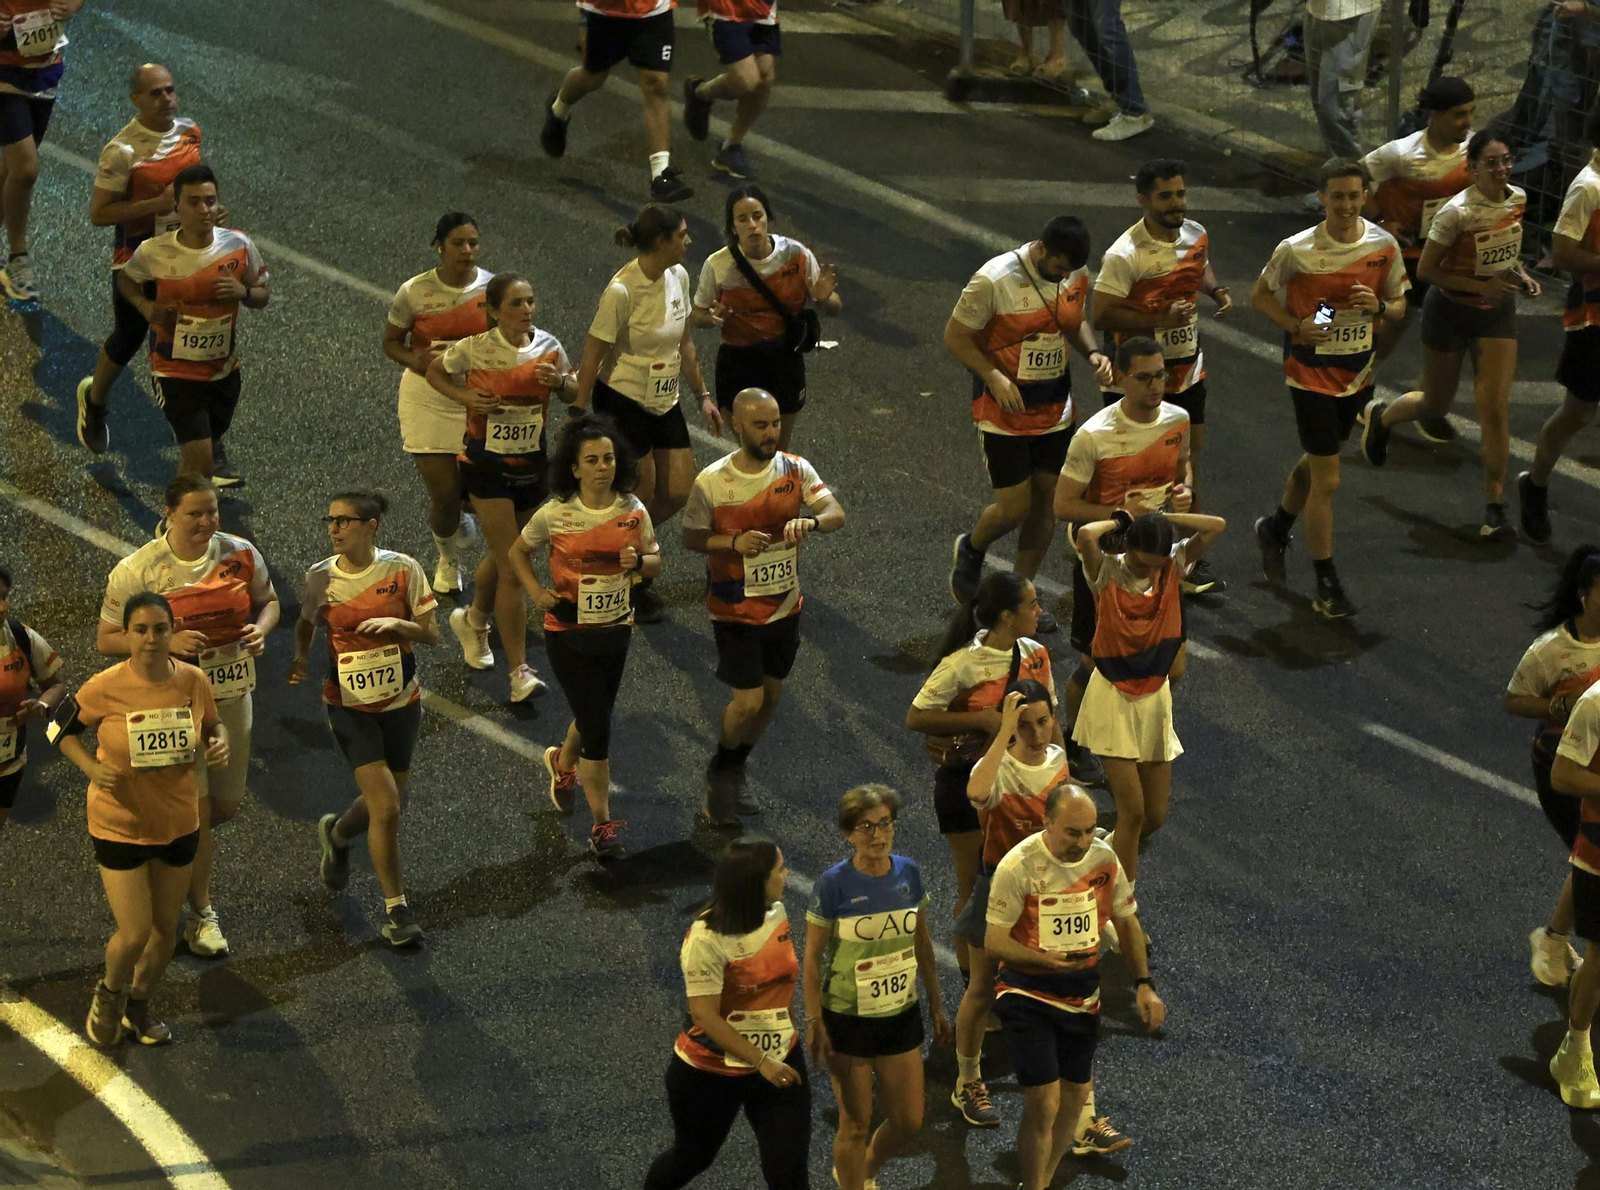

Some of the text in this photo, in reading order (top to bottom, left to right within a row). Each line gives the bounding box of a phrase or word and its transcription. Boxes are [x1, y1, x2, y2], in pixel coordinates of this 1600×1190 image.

[22, 23, 60, 46] 21011
[1481, 243, 1518, 266] 22253
[181, 333, 225, 349] 19273
[1162, 326, 1197, 346] 1693
[1027, 349, 1064, 367] 16118
[492, 424, 538, 441] 23817
[751, 559, 793, 583] 13735
[585, 588, 626, 610] 13742
[207, 661, 250, 686] 19421
[346, 666, 396, 691] 19172
[137, 729, 189, 751] 12815
[1053, 914, 1091, 935] 3190
[870, 973, 908, 998] 3182
[741, 1033, 782, 1052] 203
